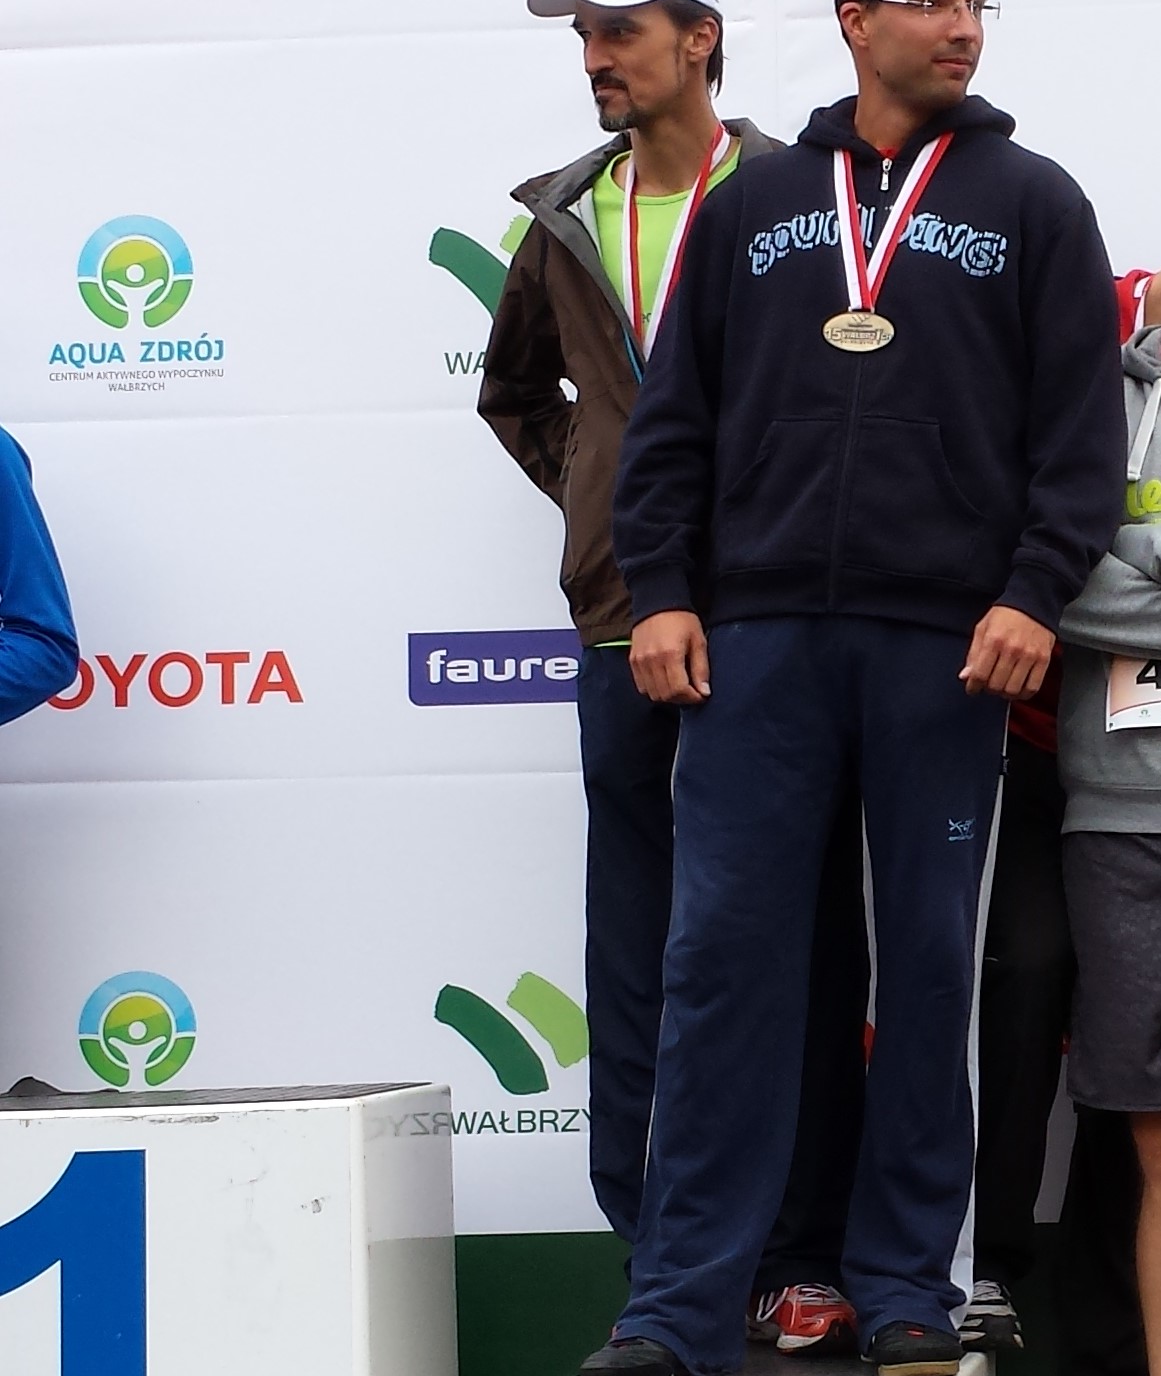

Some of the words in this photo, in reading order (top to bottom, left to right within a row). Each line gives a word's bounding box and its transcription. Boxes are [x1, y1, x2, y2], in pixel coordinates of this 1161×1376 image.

[49, 342, 125, 369] AQUA
[139, 332, 225, 362] ZDRÓJ
[49, 371, 94, 382] CENTRUM
[96, 370, 156, 381] AKTYWNEGO
[157, 368, 225, 379] WYPOCZYNKU
[108, 382, 165, 392] WAŁBRZYCH
[47, 651, 304, 710] OYOTA
[426, 648, 579, 684] faure
[452, 1108, 591, 1135] WAŁBRZ
